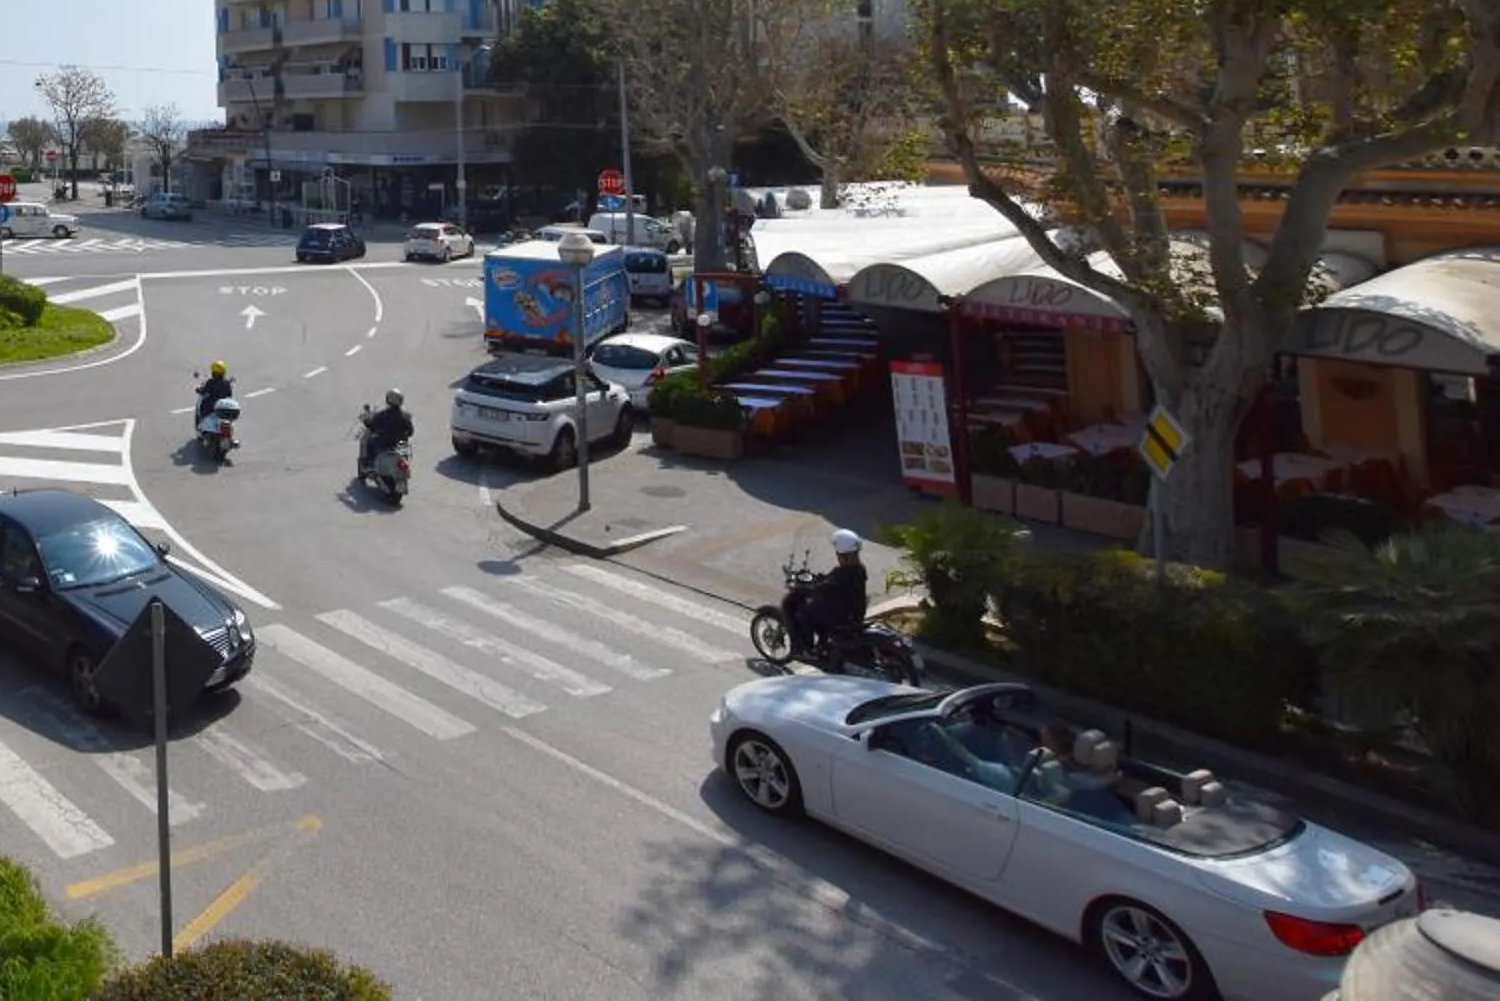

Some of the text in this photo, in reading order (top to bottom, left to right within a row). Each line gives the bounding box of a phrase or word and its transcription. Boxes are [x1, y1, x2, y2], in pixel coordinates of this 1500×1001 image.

[600, 178, 624, 190] STOP
[217, 285, 289, 296] STOP
[1011, 278, 1073, 305] LIDO
[1305, 312, 1424, 356] LIDO
